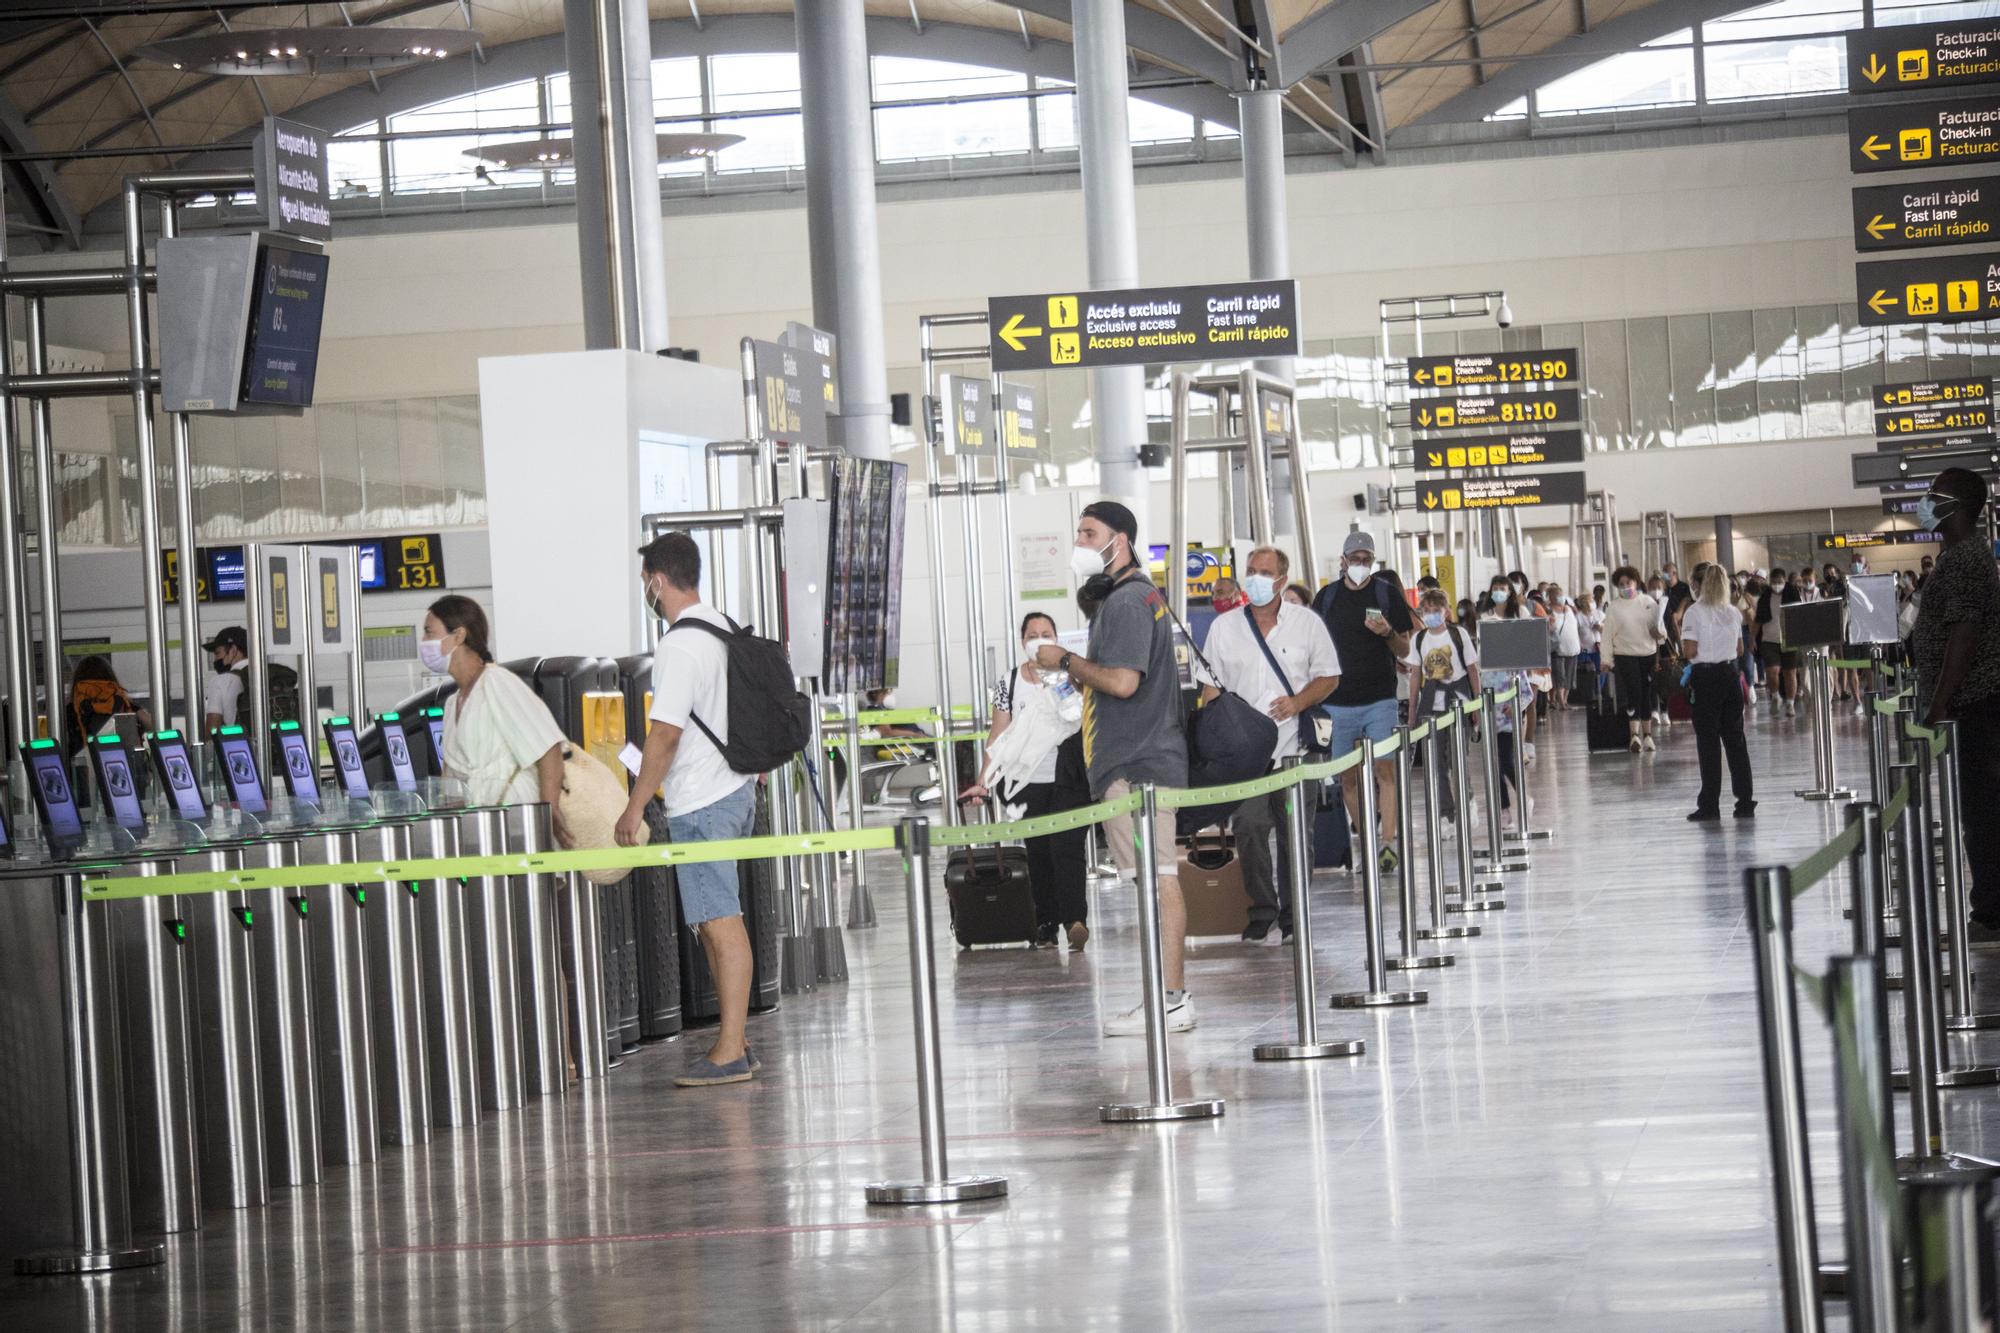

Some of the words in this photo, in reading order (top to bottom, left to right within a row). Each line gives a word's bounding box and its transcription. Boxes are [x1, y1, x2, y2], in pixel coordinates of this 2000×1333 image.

[1937, 46, 1987, 61] Check-in
[1937, 60, 2000, 77] Facturaci
[1940, 126, 1991, 140] Check-in
[276, 128, 309, 156] Aeropuerto
[309, 136, 318, 158] de
[1903, 192, 1940, 208] Carril
[1944, 189, 1980, 206] ràpid
[280, 196, 299, 223] Miguel
[1905, 211, 1928, 223] Fast
[1932, 209, 1957, 220] lane
[1905, 224, 1941, 239] Carril
[1946, 221, 1989, 237] rápido
[1206, 296, 1243, 313] Carril
[1246, 295, 1281, 311] ràpid
[1989, 296, 2000, 308] A
[1086, 304, 1126, 320] Accés
[1128, 301, 1181, 317] exclusiu
[273, 307, 283, 331] 03
[1087, 320, 1137, 334] Exclusive
[1139, 319, 1177, 331] access
[1207, 314, 1231, 327] Fast
[1233, 313, 1257, 325] lane
[1088, 334, 1135, 350] Acceso
[1137, 331, 1197, 347] exclusivo
[1208, 327, 1244, 343] Carril
[1247, 325, 1289, 342] rápido
[1454, 357, 1493, 367] Facturació
[1455, 366, 1483, 375] Check-in
[1456, 374, 1497, 384] Facturación
[1458, 415, 1499, 425] Facturación
[1510, 436, 1546, 446] Arribades
[1511, 453, 1545, 463] Llegadas
[1463, 480, 1504, 491] Equipatges
[1505, 479, 1541, 489] especials
[1463, 498, 1500, 509] Equipajes
[1502, 495, 1541, 505] especiales
[398, 565, 440, 588] 131
[164, 579, 208, 601] 12
[1186, 582, 1212, 593] TM
